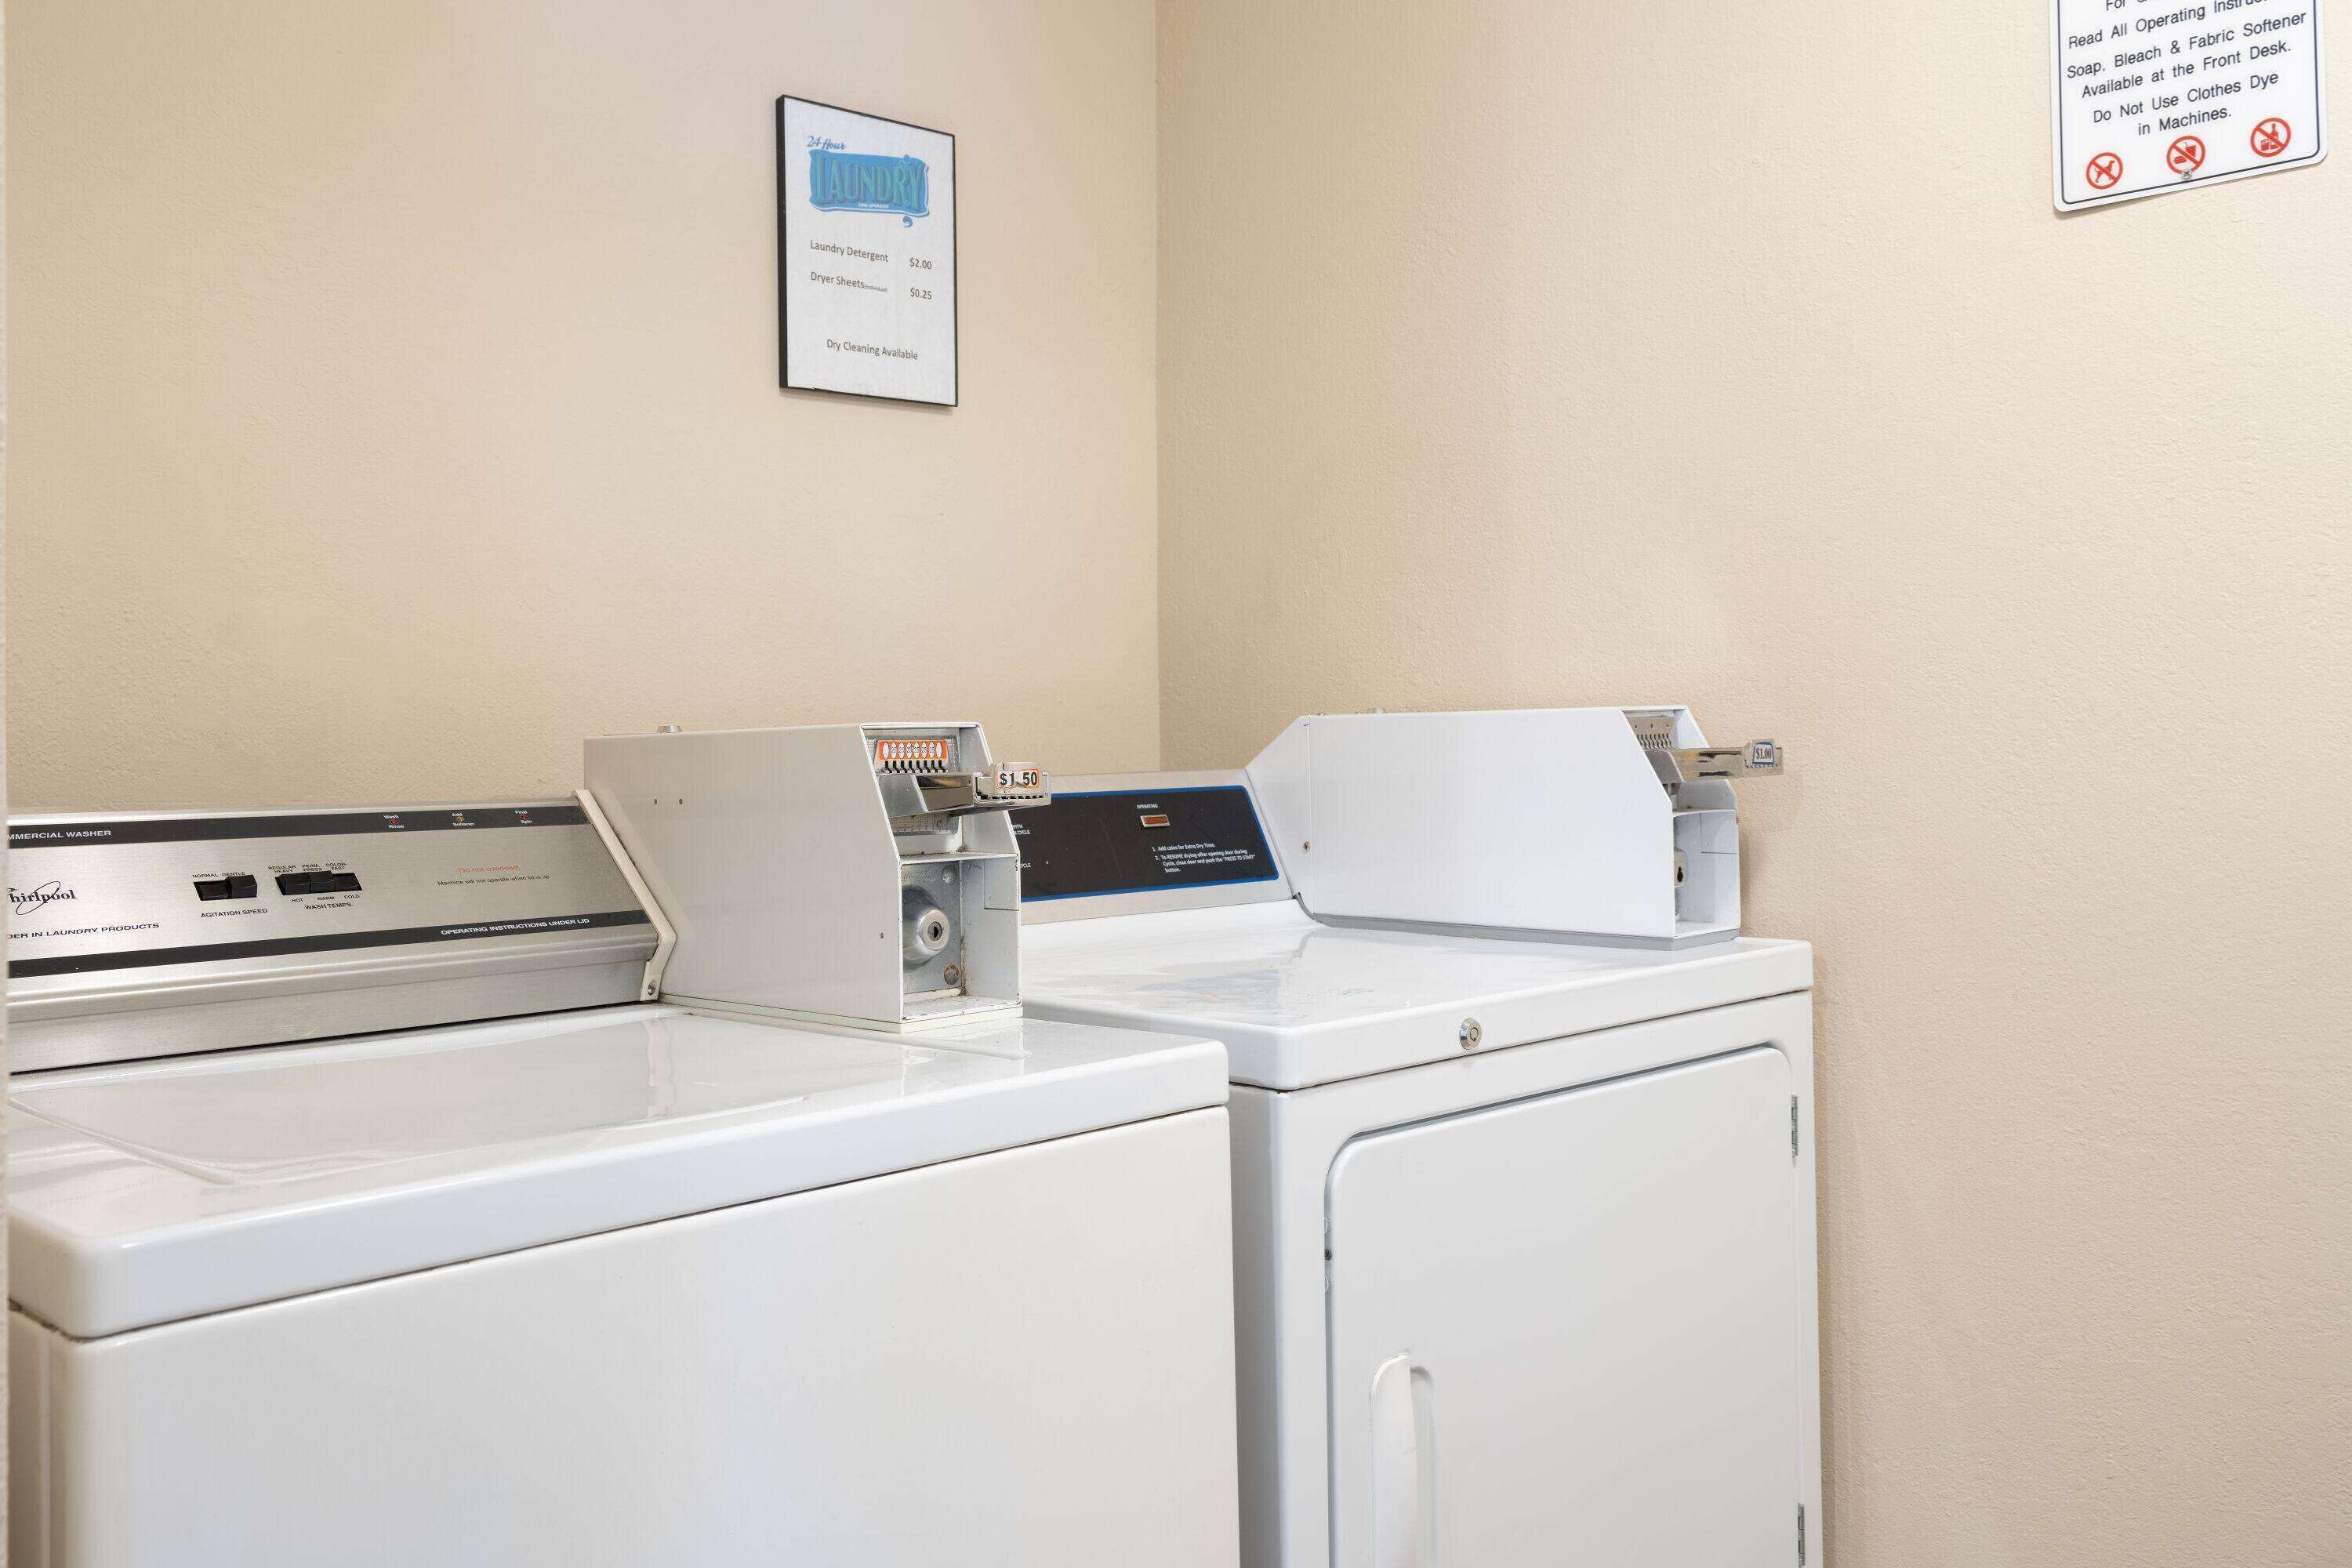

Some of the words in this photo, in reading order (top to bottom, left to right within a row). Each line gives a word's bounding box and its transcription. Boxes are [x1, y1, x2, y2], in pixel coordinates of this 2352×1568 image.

[2068, 29, 2103, 49] Read
[2111, 23, 2127, 38] All
[2136, 6, 2205, 32] Operating
[2114, 45, 2161, 67] Bleach
[2170, 40, 2181, 54] &
[2189, 29, 2234, 49] Fabric
[2243, 13, 2307, 37] Softener
[2082, 74, 2143, 98] Available
[2151, 68, 2165, 82] at
[2172, 64, 2194, 77] the
[2203, 51, 2241, 71] Front
[2250, 40, 2291, 60] Desk.
[2093, 110, 2111, 123] Do
[2120, 101, 2143, 117] Not
[2152, 96, 2179, 110] Use
[2187, 82, 2241, 102] Clothes
[2250, 73, 2278, 90] Dye
[2138, 123, 2151, 136] in
[2159, 107, 2232, 132] Machines.
[806, 135, 821, 147] 24
[821, 139, 846, 150] Hour
[810, 240, 844, 256] Laundry
[847, 246, 888, 263] Detergent
[909, 257, 932, 270] $2.00
[811, 271, 834, 284] Dryer
[909, 286, 932, 299] $0.25
[826, 339, 841, 351] Dry
[843, 341, 880, 357] Cleaning
[881, 347, 918, 360] Available
[66, 829, 111, 838] WASHER
[47, 927, 97, 936] LAUNDRY
[101, 923, 160, 932] PRODUCTS
[441, 926, 488, 935] OPERATING
[489, 921, 548, 931] INSTRUCTIONS
